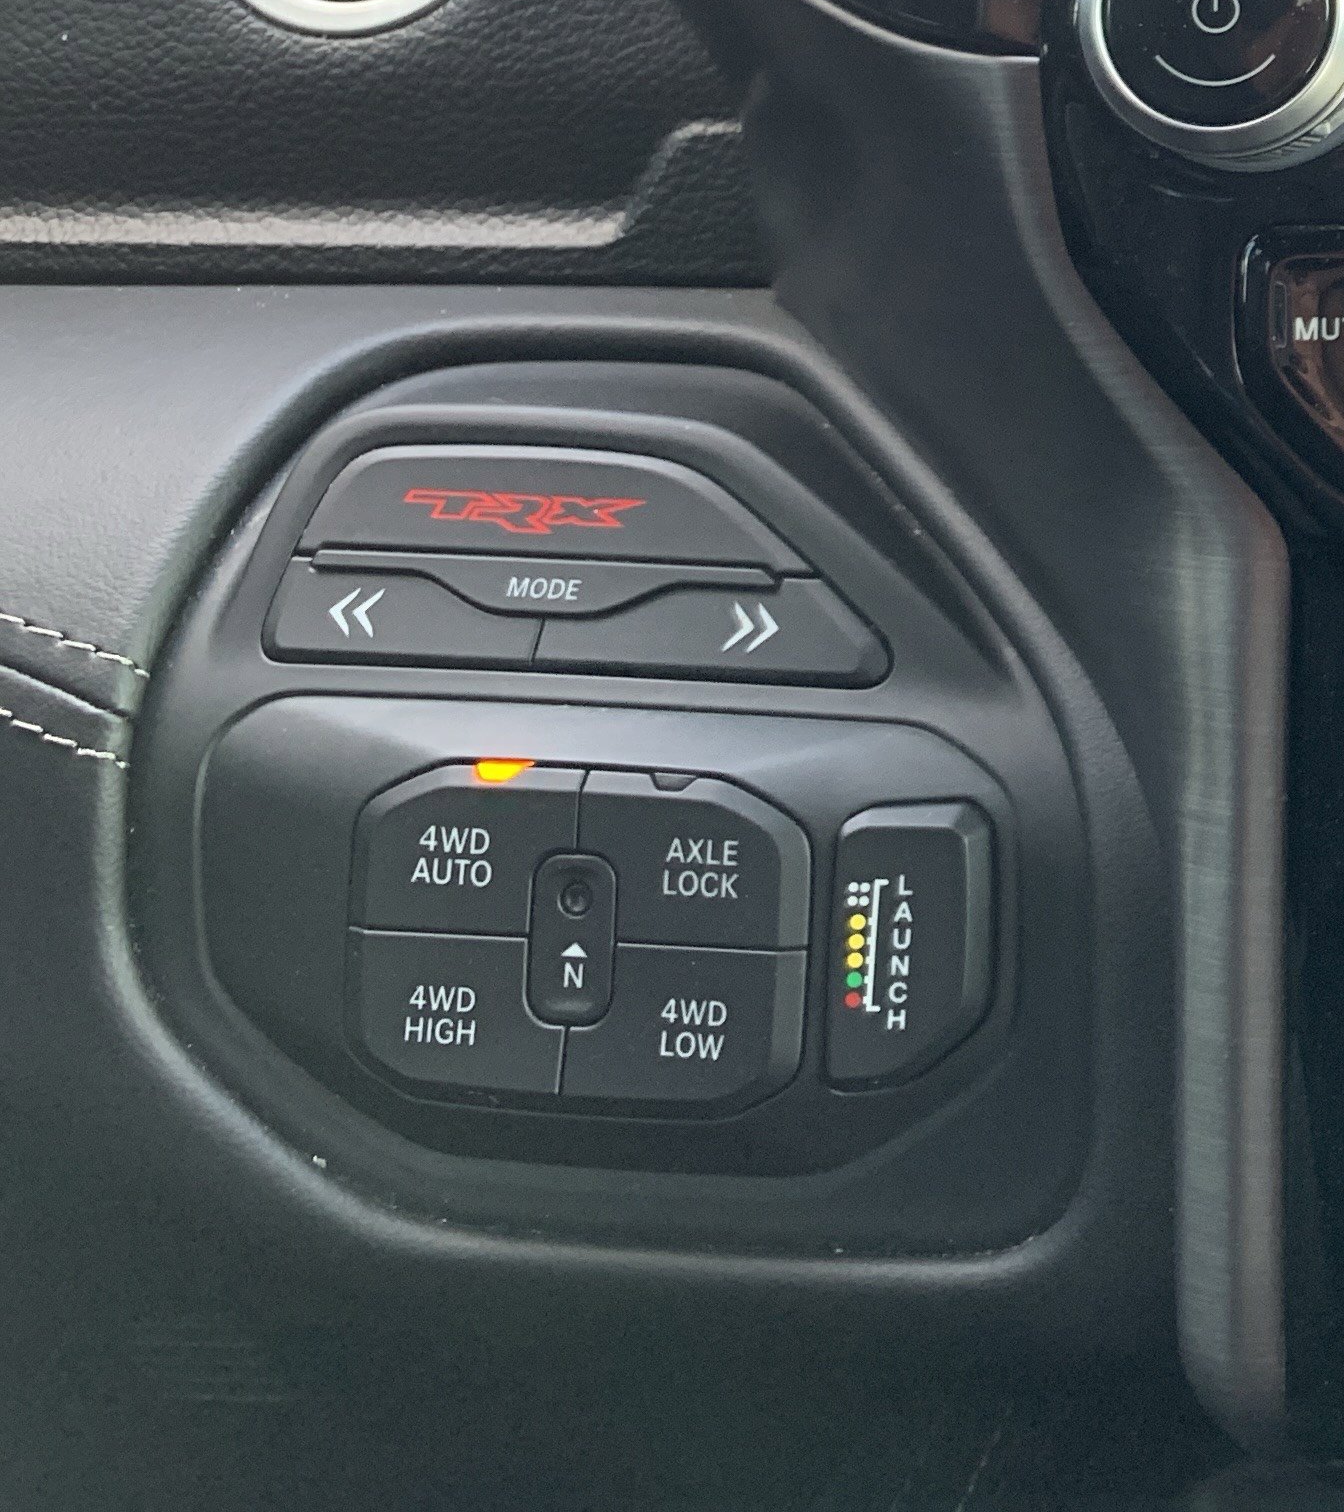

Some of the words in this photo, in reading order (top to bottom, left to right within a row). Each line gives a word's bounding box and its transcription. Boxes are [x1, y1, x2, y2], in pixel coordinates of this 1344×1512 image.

[506, 577, 582, 601] MODE
[419, 827, 490, 856] 4WD
[665, 839, 739, 866] AXLE
[411, 859, 493, 887] AUTO
[662, 871, 739, 899] LOCK
[563, 962, 584, 989] N
[408, 986, 476, 1014] 4WD
[660, 999, 727, 1027] 4WD
[404, 1017, 476, 1046] HIGH
[659, 1032, 725, 1061] LOW
